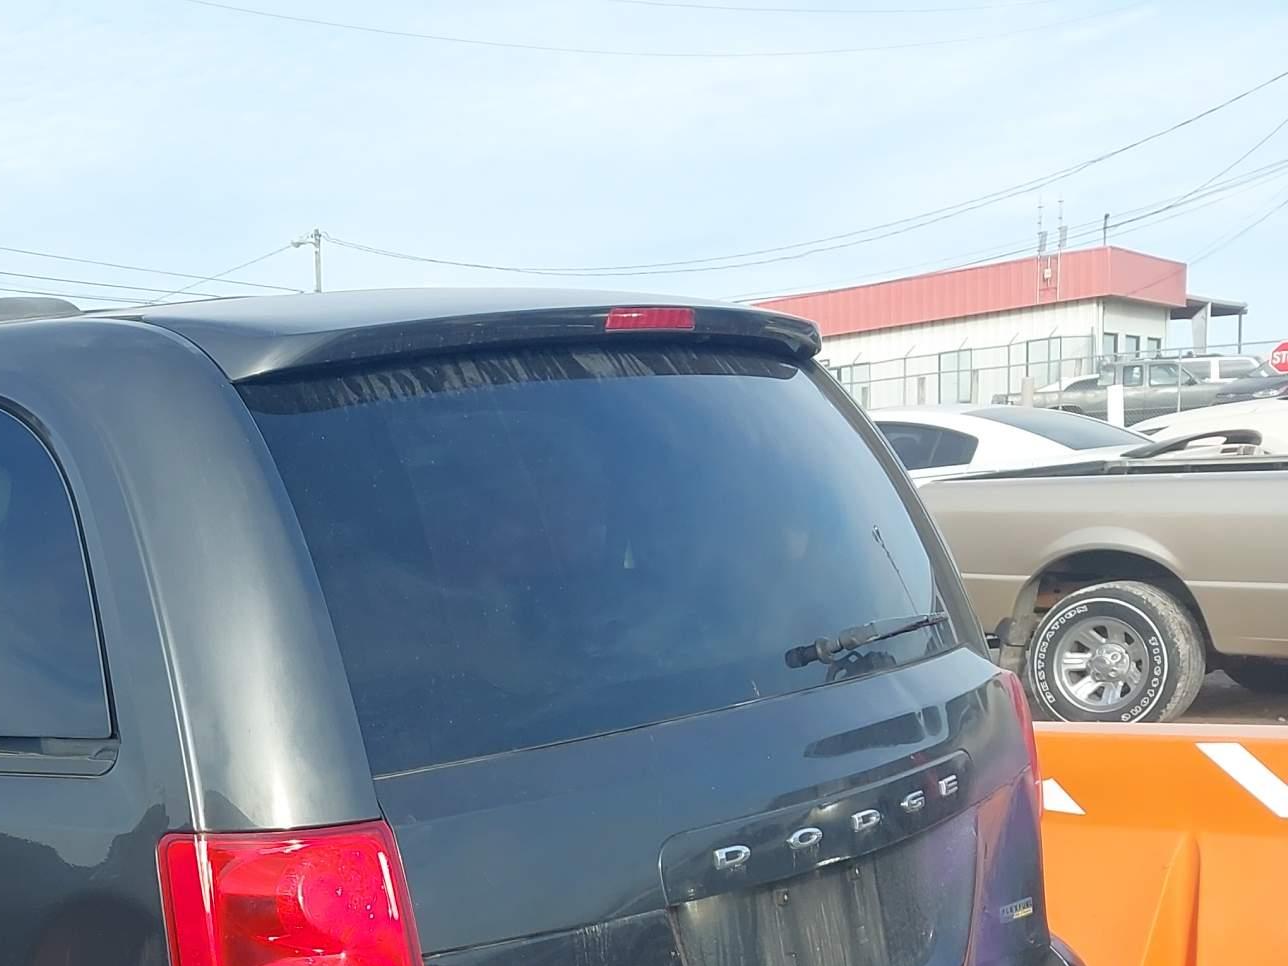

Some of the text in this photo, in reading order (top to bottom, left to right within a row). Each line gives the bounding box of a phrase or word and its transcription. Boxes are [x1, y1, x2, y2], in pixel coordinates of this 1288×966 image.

[1272, 350, 1288, 364] ST
[1038, 604, 1089, 704] DESTINATION
[713, 774, 959, 871] DODGE
